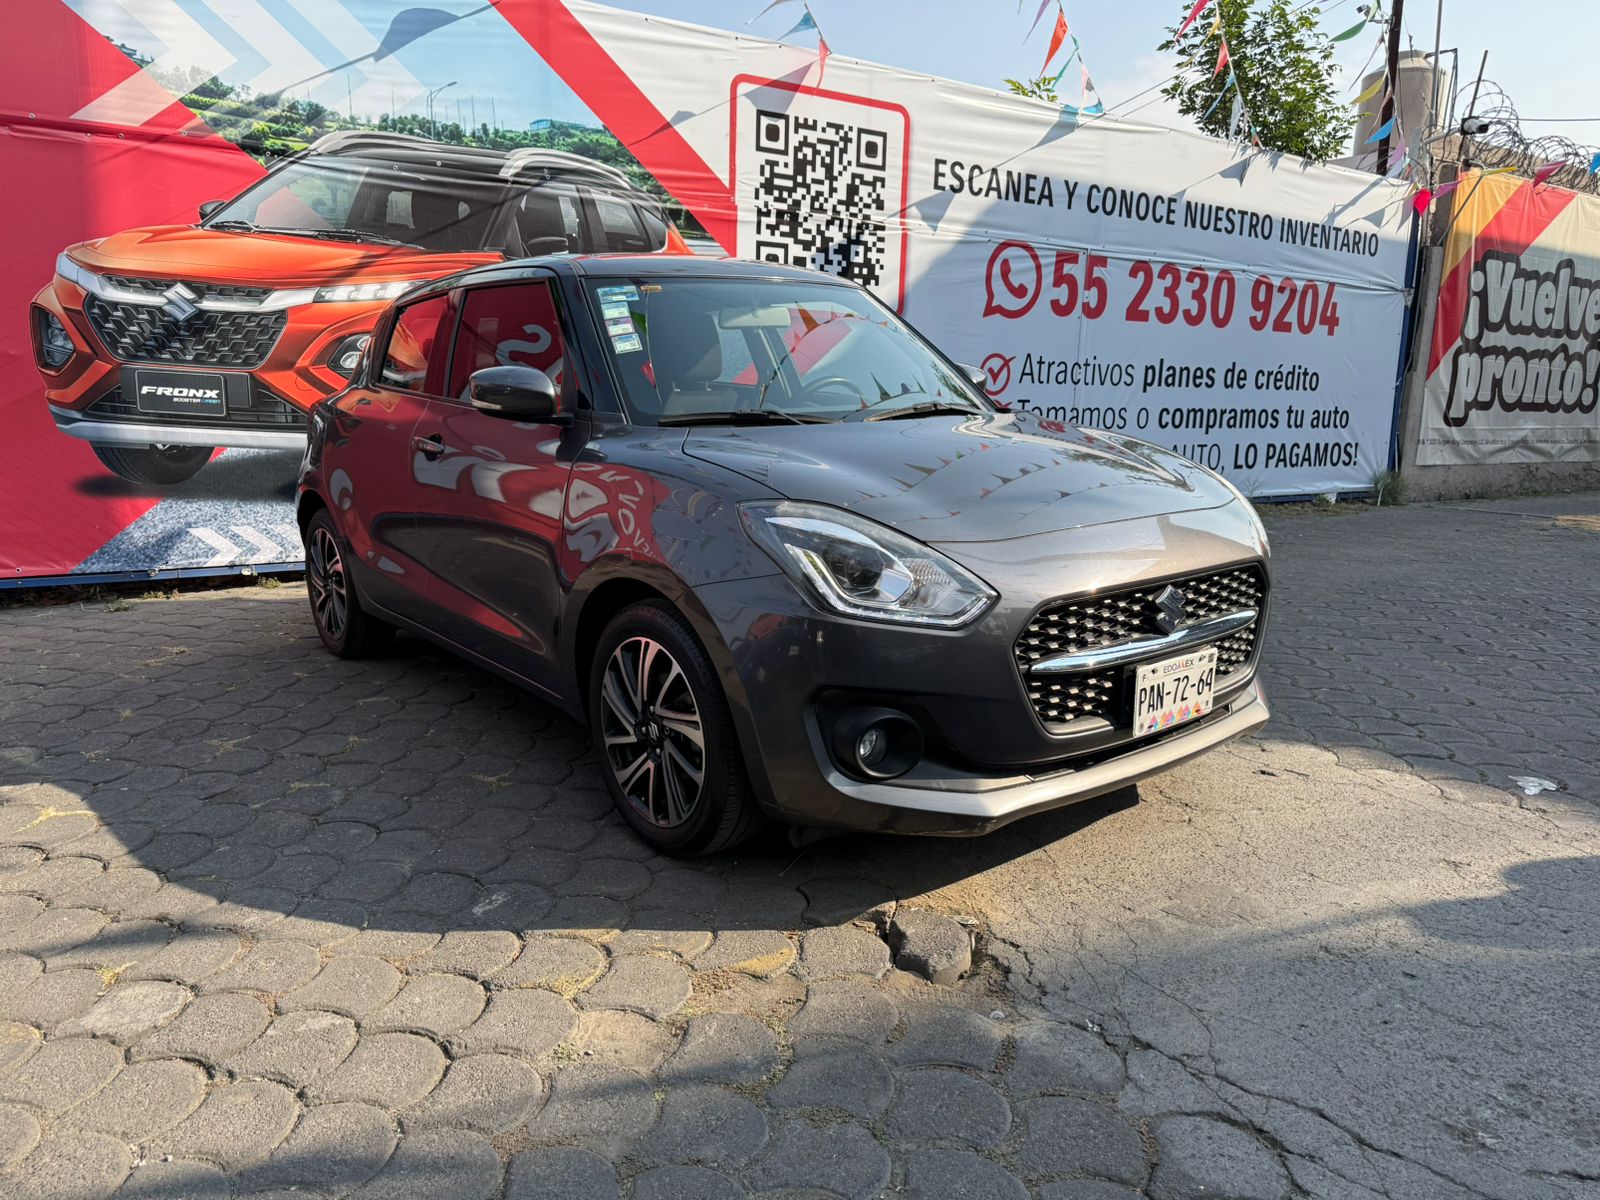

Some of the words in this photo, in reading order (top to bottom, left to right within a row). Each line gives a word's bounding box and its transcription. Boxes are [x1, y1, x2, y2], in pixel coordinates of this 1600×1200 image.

[933, 158, 1054, 208] ESCANEA
[1063, 179, 1079, 210] Y
[1086, 183, 1178, 226] CONOCE
[1183, 199, 1273, 241] NUESTRO
[1279, 217, 1379, 257] INVENTARIO
[1050, 250, 1108, 319] 55
[1125, 260, 1236, 329] 2330
[1249, 274, 1340, 337] 9204
[140, 385, 220, 399] FRONX
[1018, 352, 1135, 388] Atractivos
[1142, 358, 1216, 393] planes
[1223, 361, 1248, 390] de
[1255, 363, 1320, 392] crédito
[1446, 348, 1600, 424] pronto!
[1136, 407, 1149, 430] o
[1158, 405, 1280, 435] compramos
[1286, 405, 1304, 430] tu
[1310, 406, 1350, 430] auto
[1233, 443, 1258, 470] LO
[1265, 441, 1359, 470] PAGAMOS!
[1138, 667, 1214, 717] PAN-72-64
